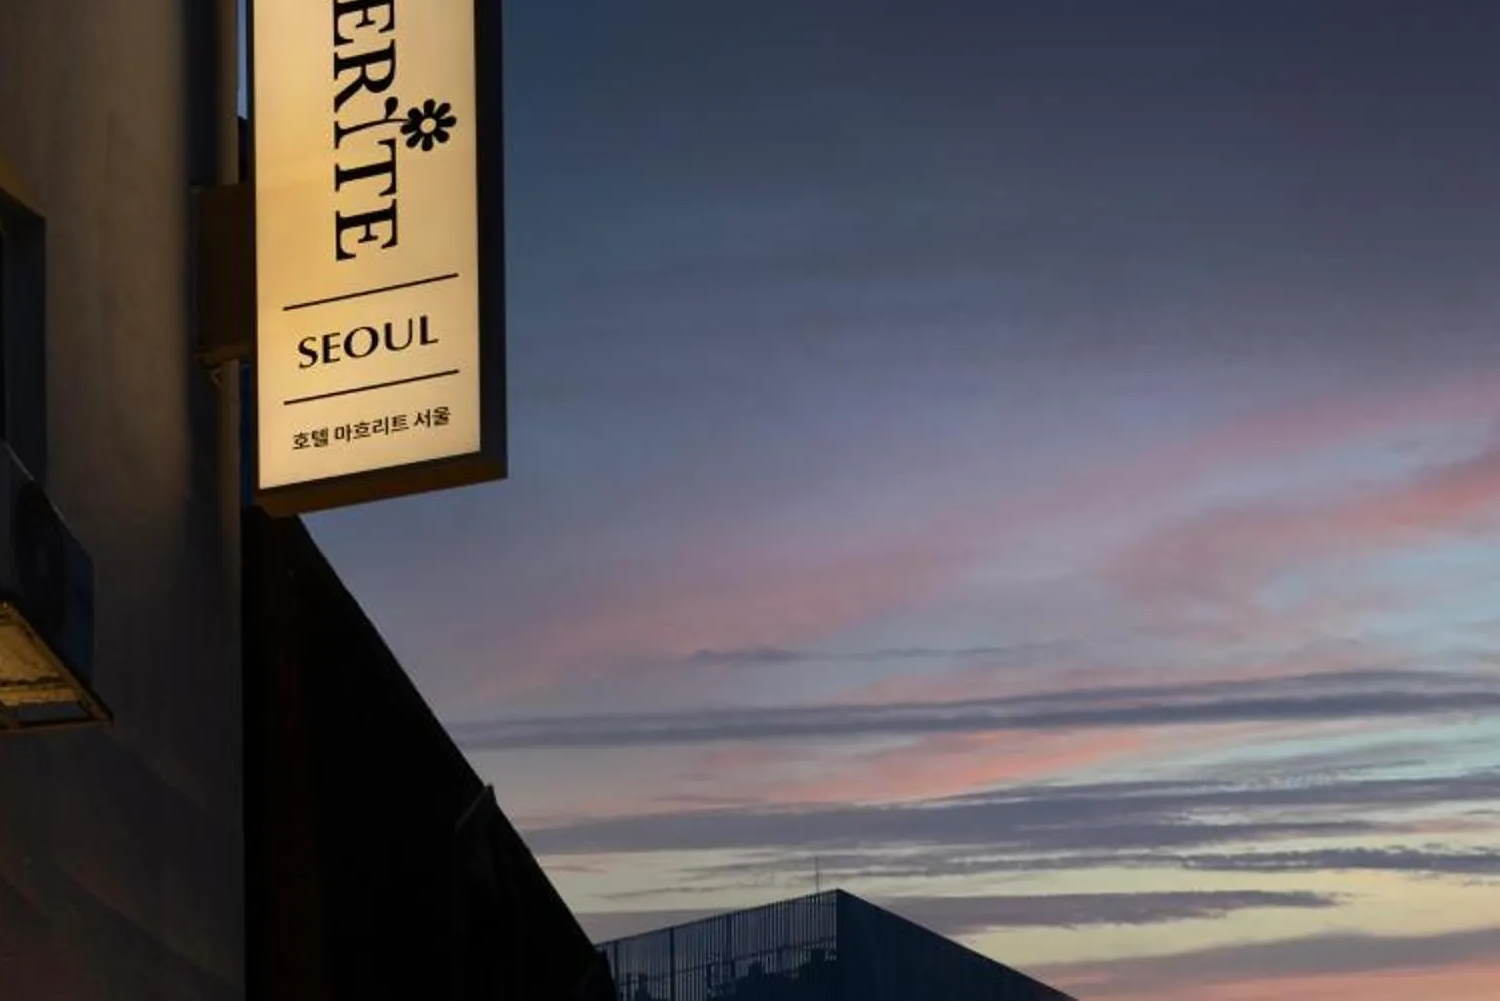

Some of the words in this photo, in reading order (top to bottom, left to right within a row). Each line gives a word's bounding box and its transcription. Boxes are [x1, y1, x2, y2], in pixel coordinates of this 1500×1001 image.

[298, 315, 440, 369] SEOUL
[292, 427, 329, 450] 호텔
[334, 413, 409, 442] 마흐리트
[413, 406, 451, 429] 서울
